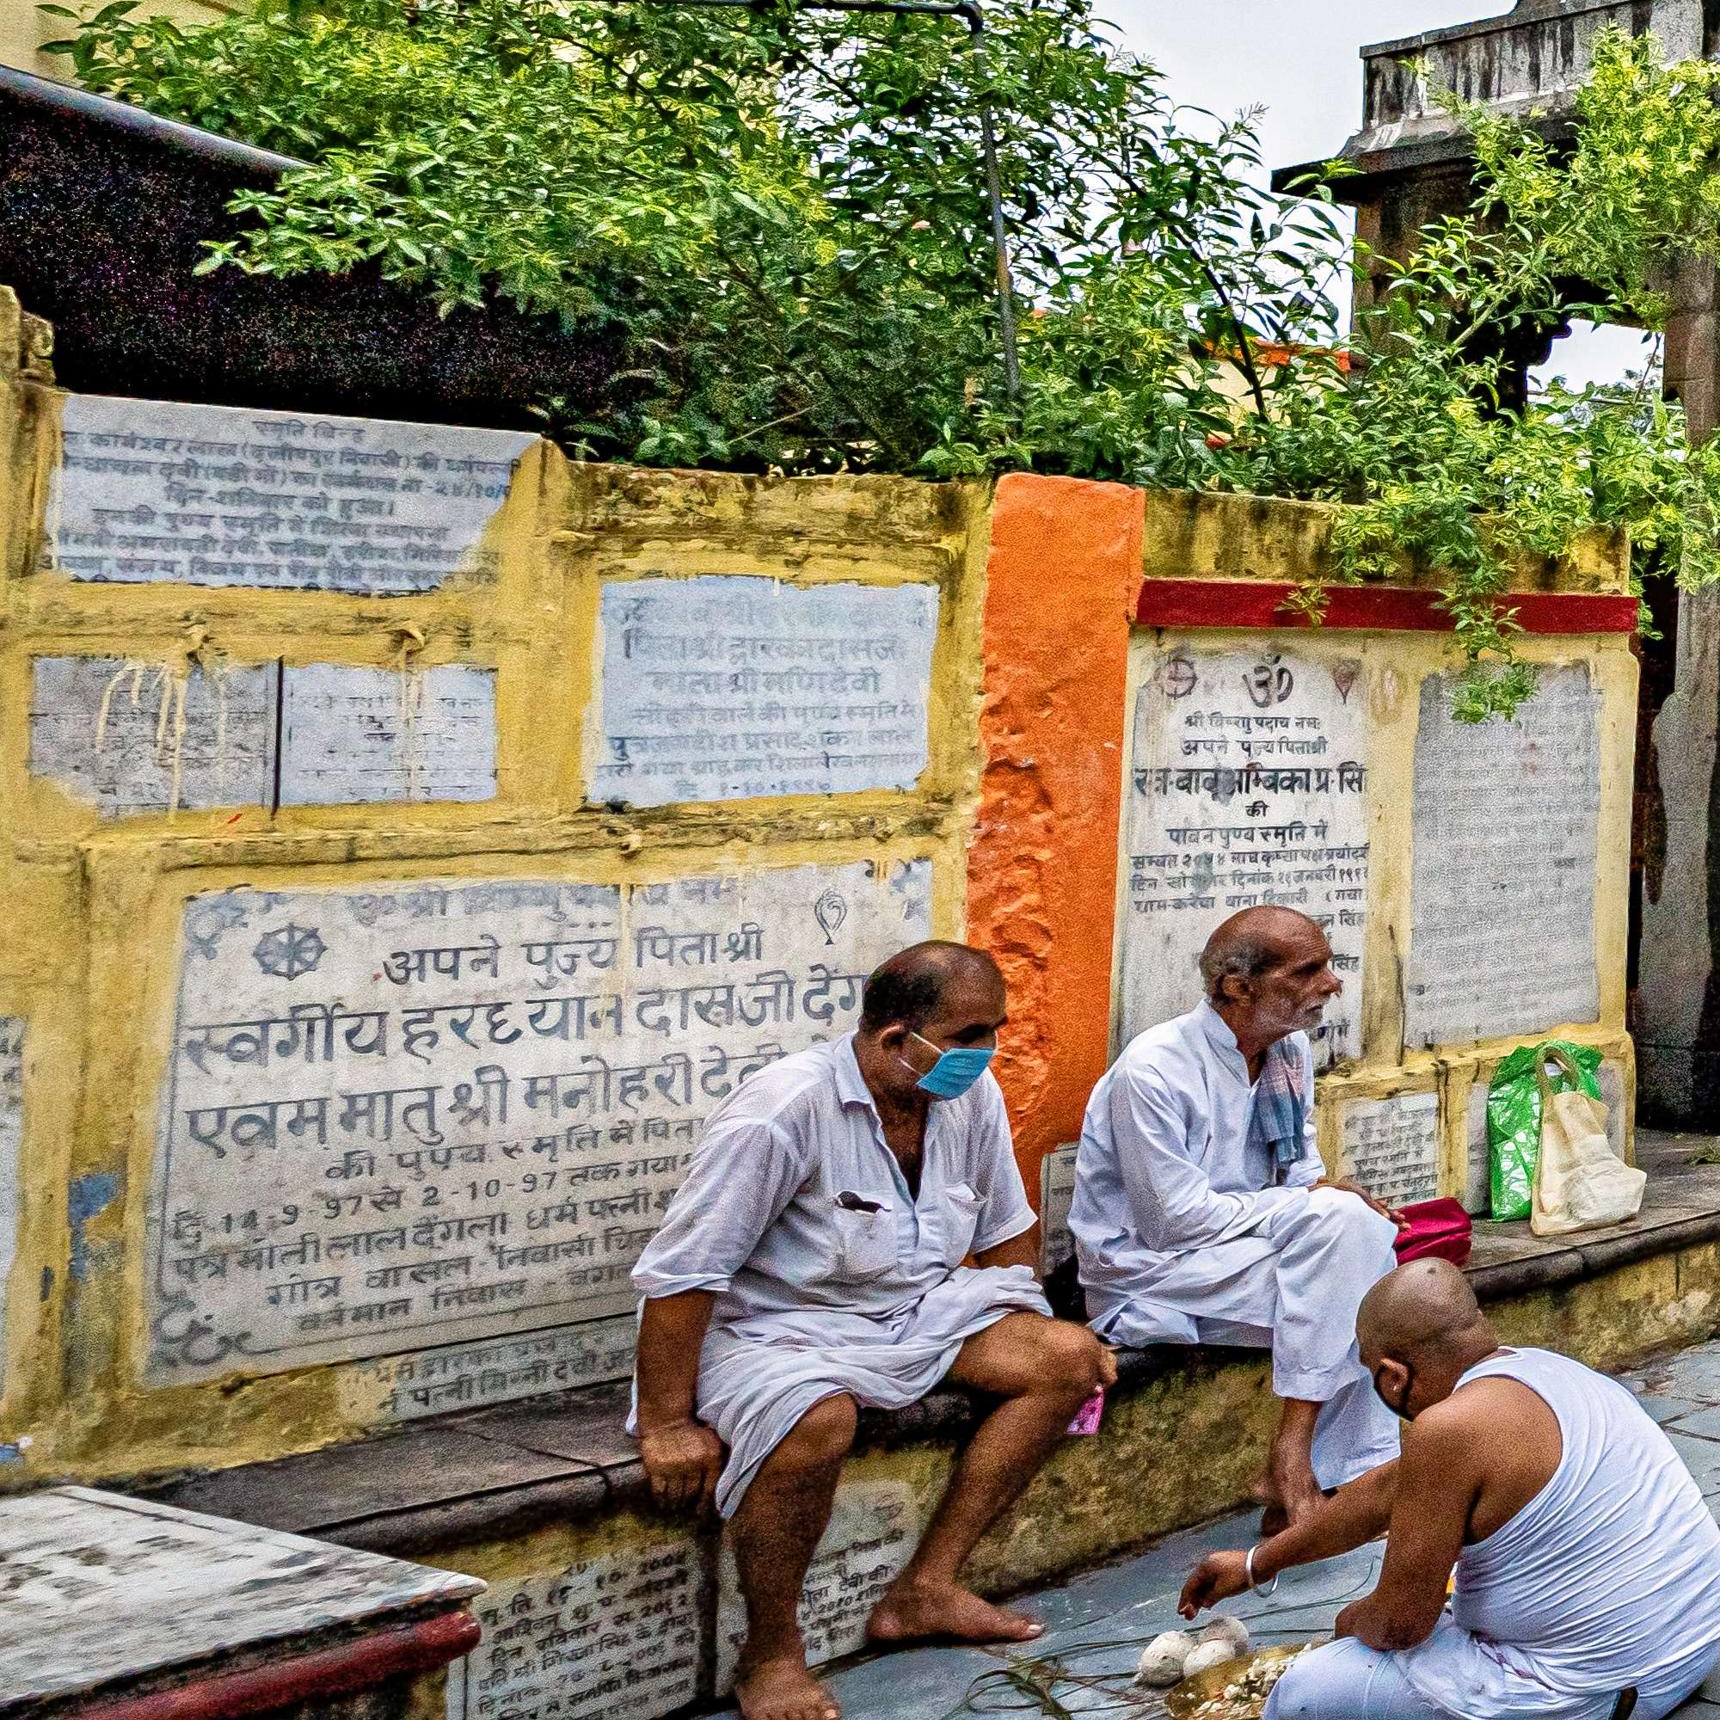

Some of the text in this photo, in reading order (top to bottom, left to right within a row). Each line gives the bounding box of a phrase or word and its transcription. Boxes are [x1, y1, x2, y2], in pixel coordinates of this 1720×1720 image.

[1336, 760, 1368, 796] सिं
[1245, 800, 1270, 818] की
[1256, 820, 1308, 848] स्मृति
[382, 932, 503, 987] अपने
[633, 925, 721, 970] पिता
[720, 920, 766, 964] श्री
[186, 968, 797, 1076] स्वर्गीय दास जी
[339, 1084, 445, 1148] मातु
[447, 1063, 512, 1128] श्री
[521, 1050, 695, 1120] मनोहरी
[325, 1148, 378, 1181] की
[498, 1123, 604, 1164] स्मृति
[369, 1184, 406, 1213] से
[563, 1159, 623, 1189] तक
[525, 1194, 579, 1233] धर्म
[585, 1185, 653, 1222] पत्नी
[265, 1271, 344, 1307] गोत्र
